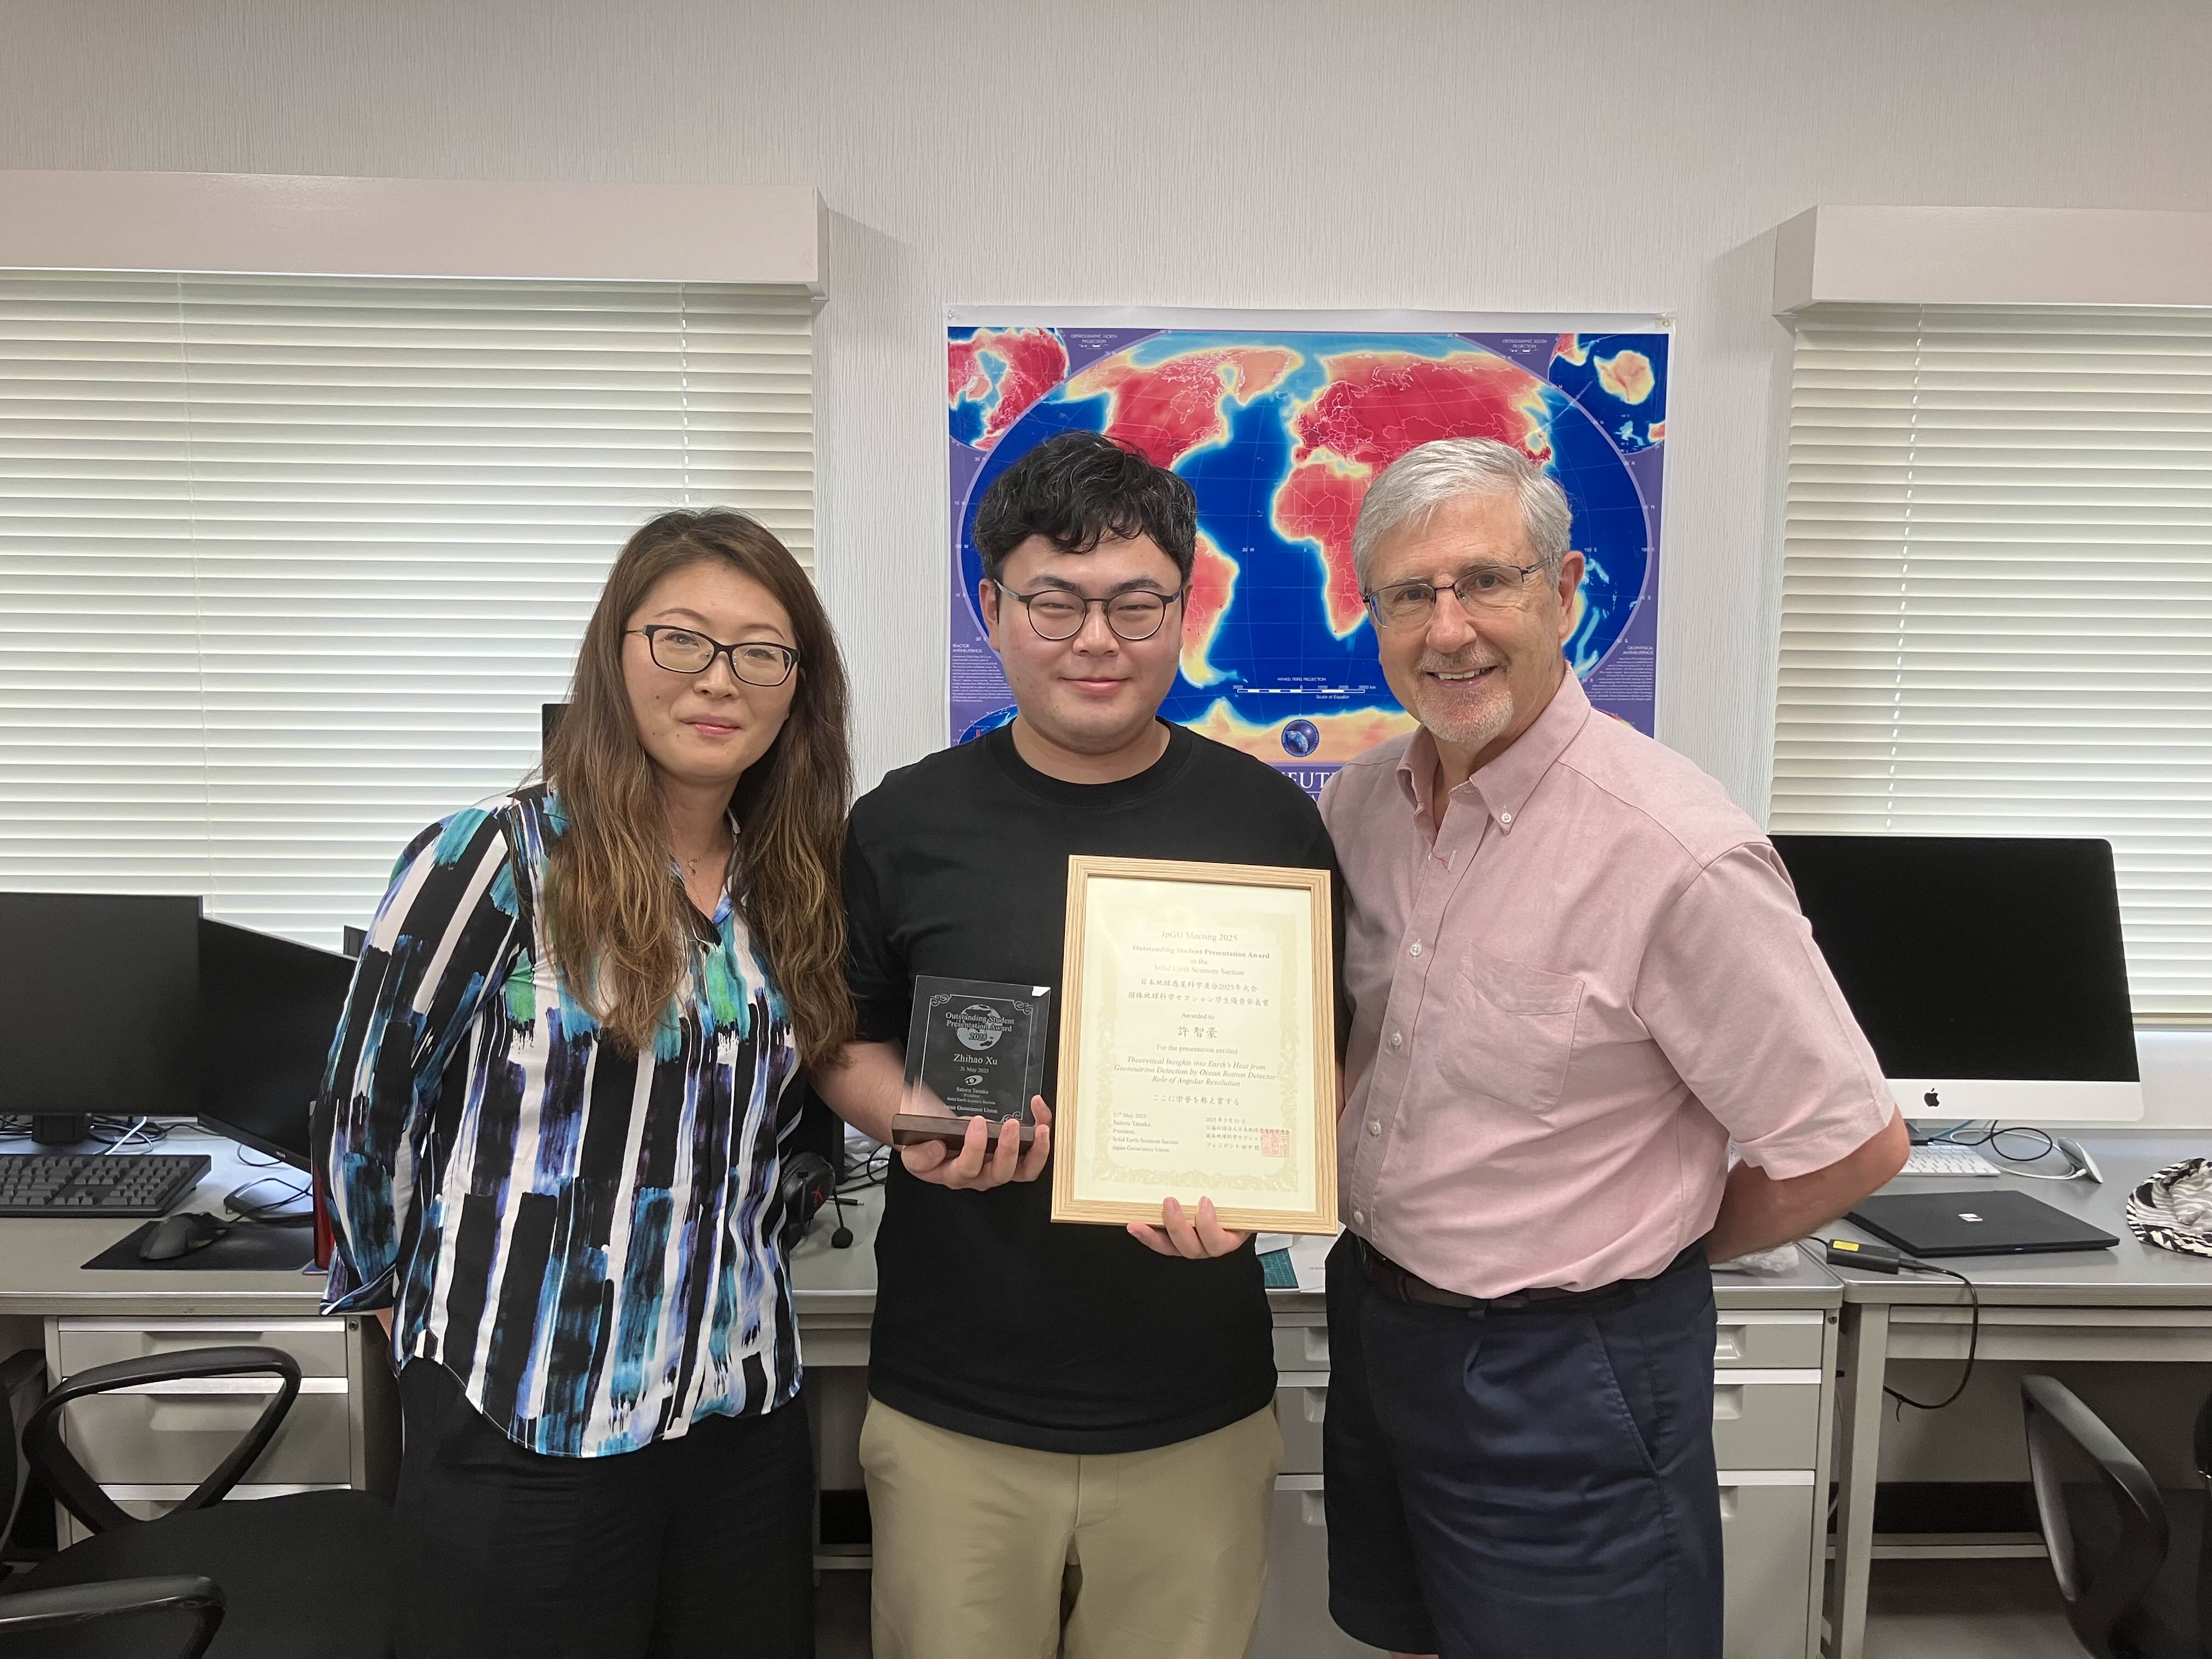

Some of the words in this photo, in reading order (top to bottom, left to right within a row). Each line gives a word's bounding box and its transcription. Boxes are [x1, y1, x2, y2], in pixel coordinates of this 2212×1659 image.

[1282, 772, 1339, 788] EUT
[1161, 931, 1183, 939] JpGU
[1186, 933, 1217, 941] Meeting
[1218, 934, 1238, 942] 2025
[1132, 944, 1175, 954] Outstanding
[1176, 947, 1203, 955] Student
[1204, 949, 1246, 957] Presentation
[945, 1012, 987, 1023] Outstanding
[987, 1016, 1014, 1025] Student
[946, 1019, 988, 1030] Presentation
[989, 1023, 1012, 1032] Award
[969, 1032, 988, 1041] 2025
[953, 1053, 983, 1064] Zhihao
[985, 1057, 998, 1065] Xu
[1127, 1056, 1164, 1065] Theoretical
[1166, 1058, 1192, 1066] Insights
[1249, 1063, 1266, 1071] from
[1114, 1064, 1155, 1073] Geoneutrino
[1156, 1066, 1188, 1075] Detection
[1189, 1069, 1198, 1077] by
[1222, 1070, 1246, 1079] Bottom
[1169, 1076, 1177, 1085] of
[1177, 1077, 1204, 1086] Angular
[1206, 1078, 1240, 1087] Resolution
